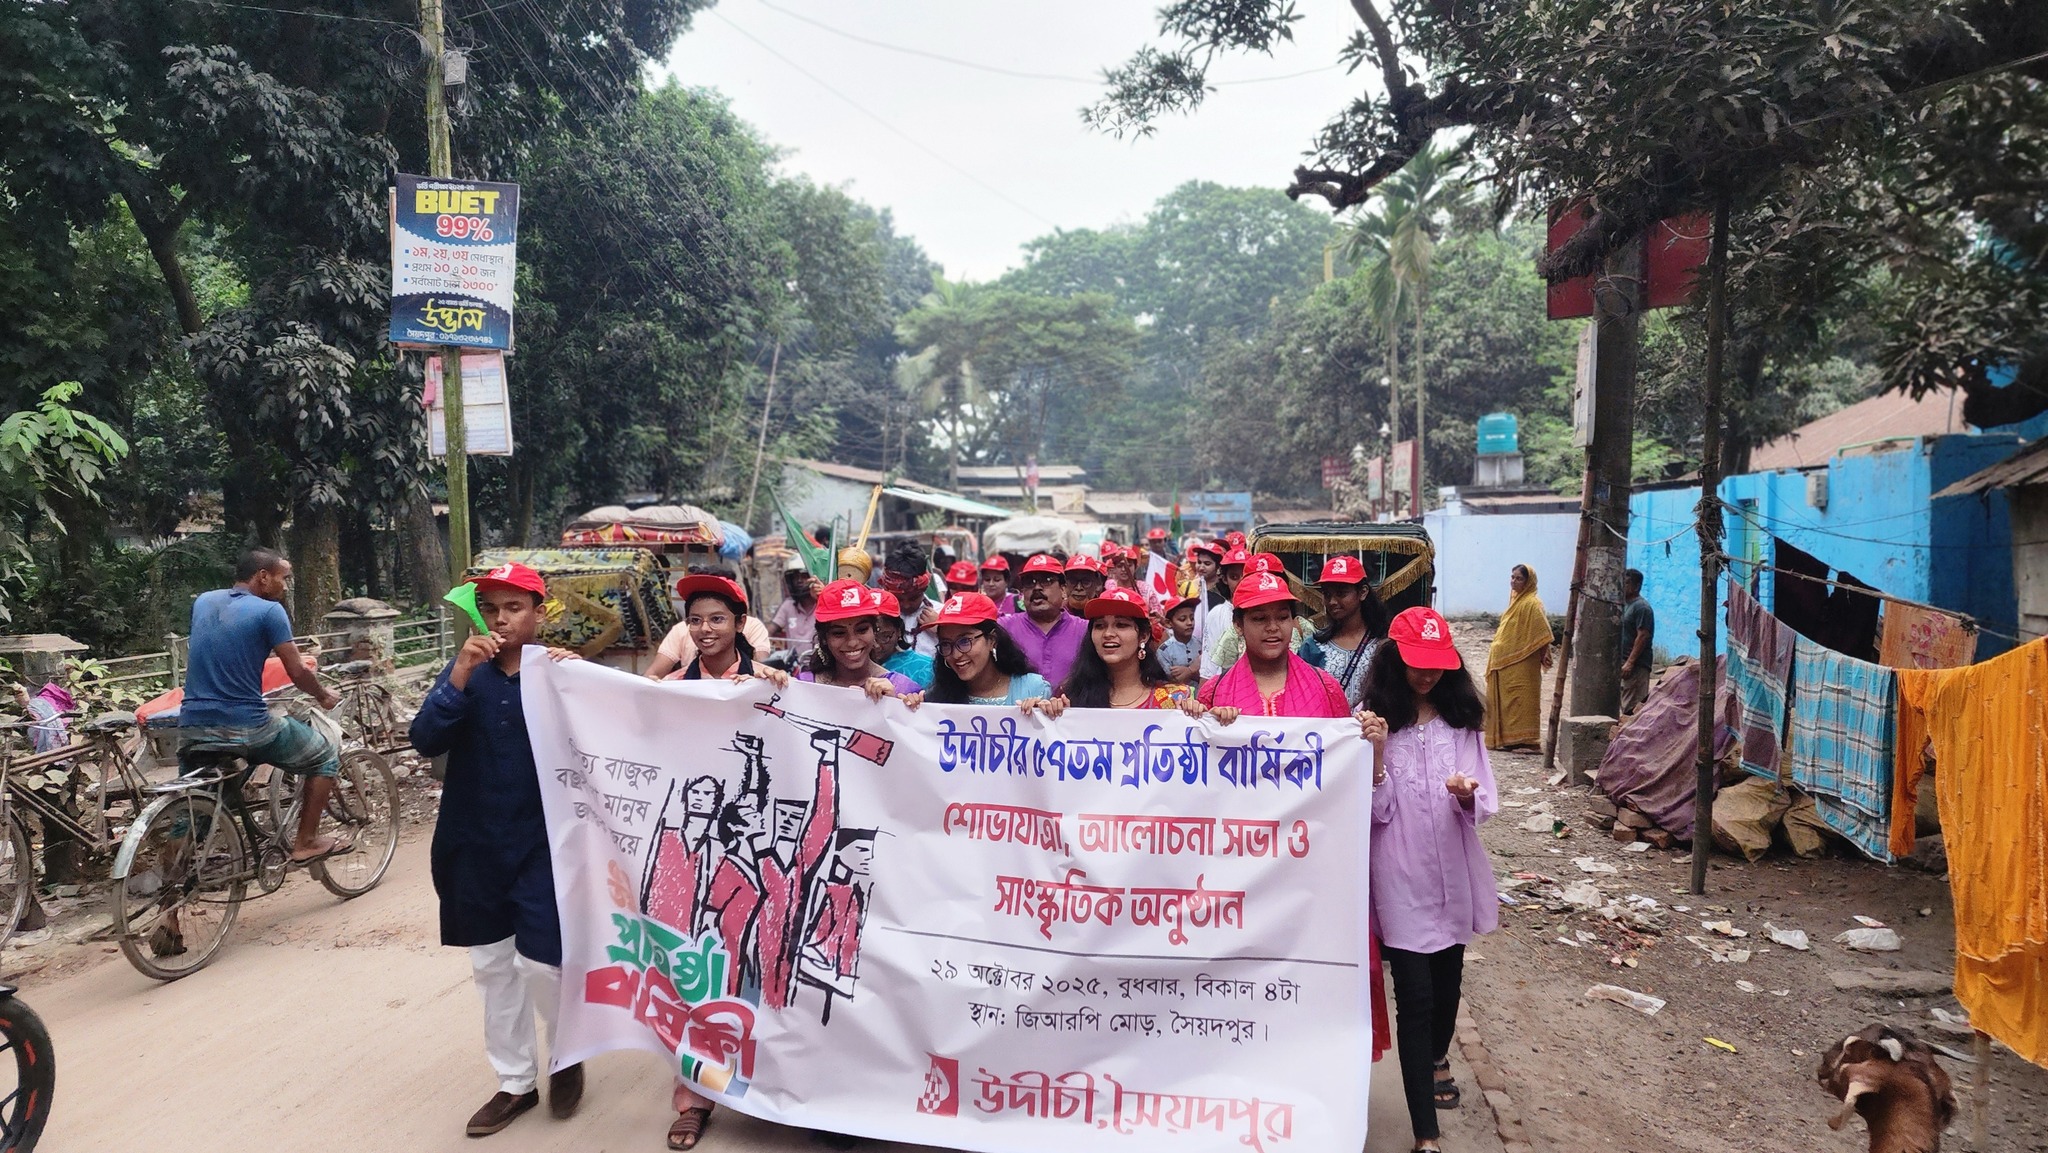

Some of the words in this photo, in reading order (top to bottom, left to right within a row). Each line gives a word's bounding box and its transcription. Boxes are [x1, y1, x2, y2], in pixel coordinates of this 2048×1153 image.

[415, 190, 499, 214] BUET
[437, 215, 493, 242] 99%
[411, 262, 432, 272] প্রথম
[433, 262, 450, 273] ১০
[461, 264, 478, 276] ১০
[480, 268, 496, 278] জন
[412, 246, 431, 259] ১ম,
[433, 248, 450, 261] ২য়,
[452, 250, 469, 262] ৩য়
[470, 253, 504, 265] মেধাস্থান
[411, 275, 441, 288] সর্বমোট
[937, 716, 1030, 778] উদীচীর
[1033, 735, 1115, 784] ৫৭তম
[1119, 724, 1210, 789] প্রতিষ্ঠা
[1217, 730, 1326, 792] বার্ষিকী
[604, 757, 661, 791] বাজুক
[603, 793, 652, 826] মানুষ
[942, 802, 1071, 857] শোভাযাত্রা,
[1078, 813, 1216, 857] আলোচনা
[1221, 817, 1281, 858] সভা
[1287, 819, 1310, 859] ও
[993, 868, 1126, 941] সাংস্কৃতিক
[1130, 872, 1246, 946] অনুষ্ঠান
[930, 960, 958, 981] ২৯
[967, 962, 1036, 993] অক্টোবর
[1041, 977, 1108, 1000] ২০২৫,
[1117, 976, 1185, 1000] বুধবার,
[1194, 973, 1255, 1002] বিকাল
[1263, 981, 1301, 1005] ৪টা
[968, 999, 1006, 1028] স্থান:
[1015, 1006, 1102, 1032] জিআরপি
[1109, 1012, 1162, 1040] মোড়,
